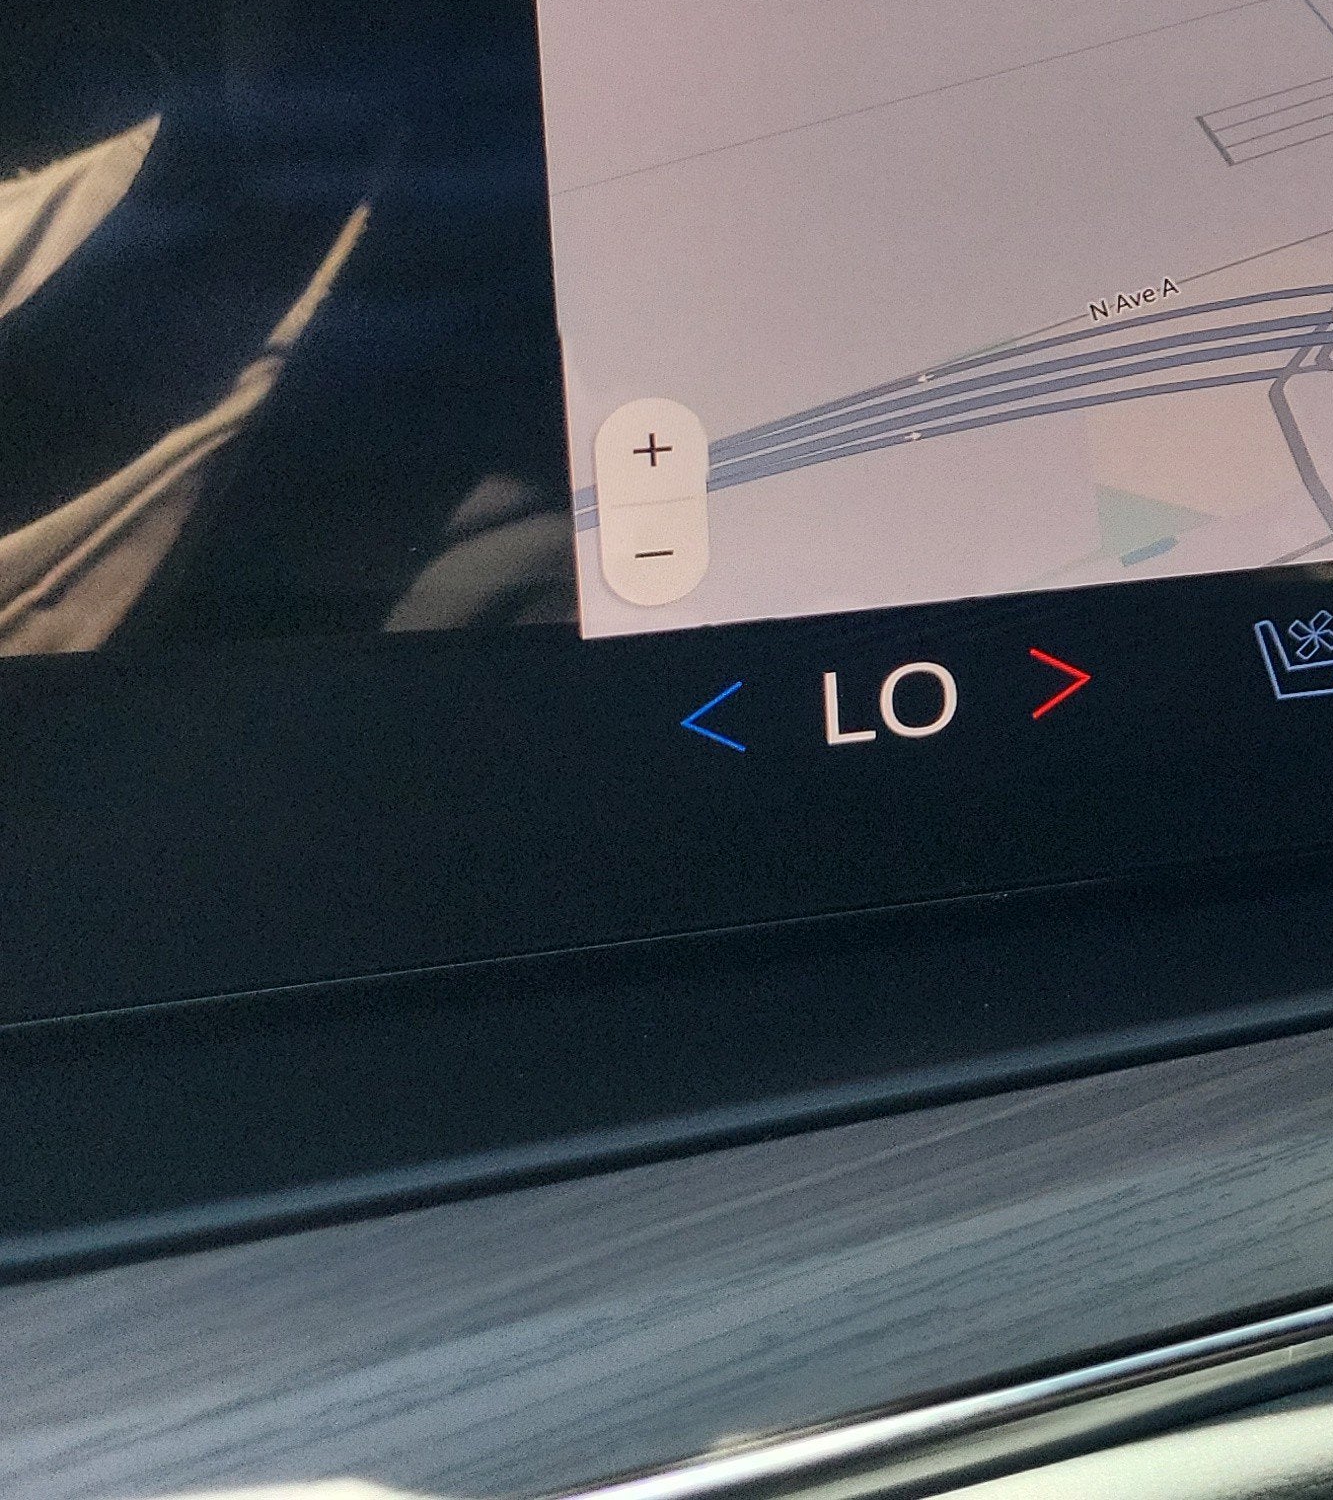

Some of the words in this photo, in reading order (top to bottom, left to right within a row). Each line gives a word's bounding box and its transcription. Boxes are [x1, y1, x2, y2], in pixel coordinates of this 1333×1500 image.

[1089, 300, 1110, 321] N
[1116, 286, 1156, 314] Ave
[1162, 278, 1179, 296] A
[823, 661, 958, 746] LO
